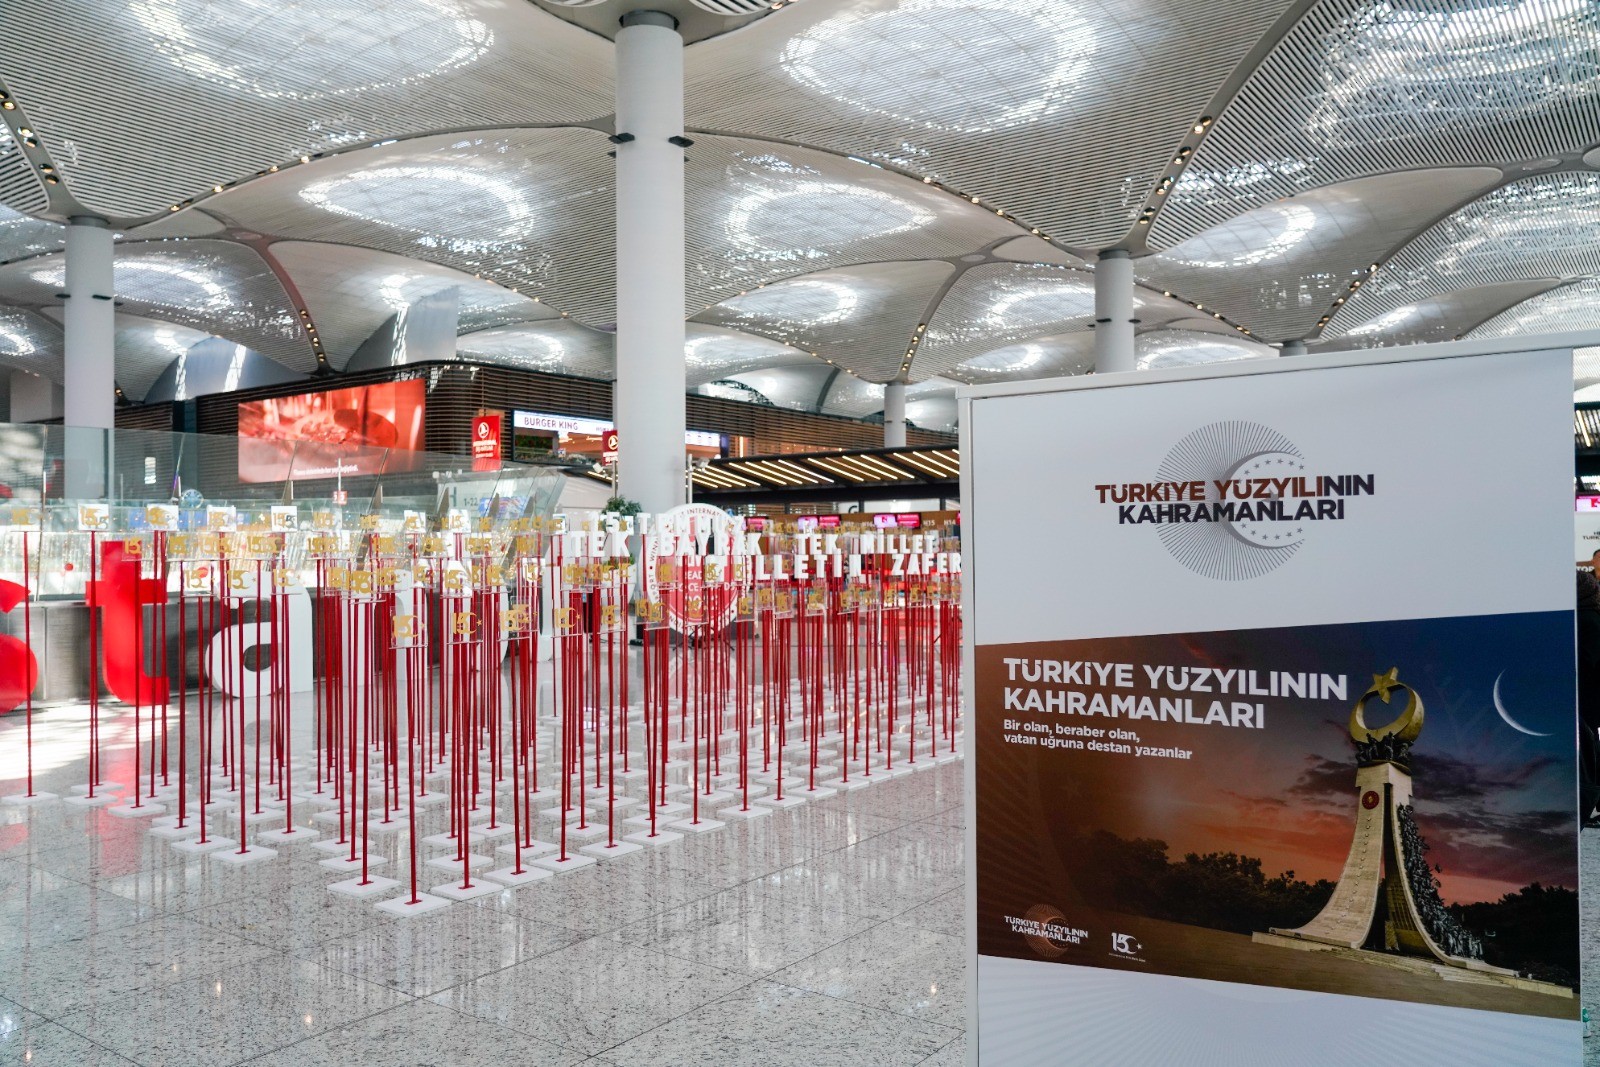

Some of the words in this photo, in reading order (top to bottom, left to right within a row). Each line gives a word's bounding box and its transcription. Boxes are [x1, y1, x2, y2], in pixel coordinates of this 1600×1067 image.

[524, 416, 556, 428] BURGER
[559, 421, 579, 431] KING
[1214, 474, 1375, 500] YÜZYILININ
[1118, 499, 1345, 524] KAHRAMANLARI
[571, 531, 630, 557] TEK
[797, 533, 842, 554] TEK
[1143, 664, 1347, 700] YÜZYILININ
[1004, 687, 1264, 729] KAHRAMANLARI
[1004, 719, 1021, 731] Bir
[1023, 722, 1052, 735] olan,
[1055, 723, 1105, 738] beraber
[1108, 729, 1141, 743] olan,
[1004, 734, 1037, 745] vatan
[1040, 736, 1084, 750] uğruna
[1087, 740, 1131, 754] destan
[1134, 746, 1192, 760] yazanlar
[1012, 924, 1080, 944] KAHRAMANLARI
[1111, 932, 1129, 953] 15
